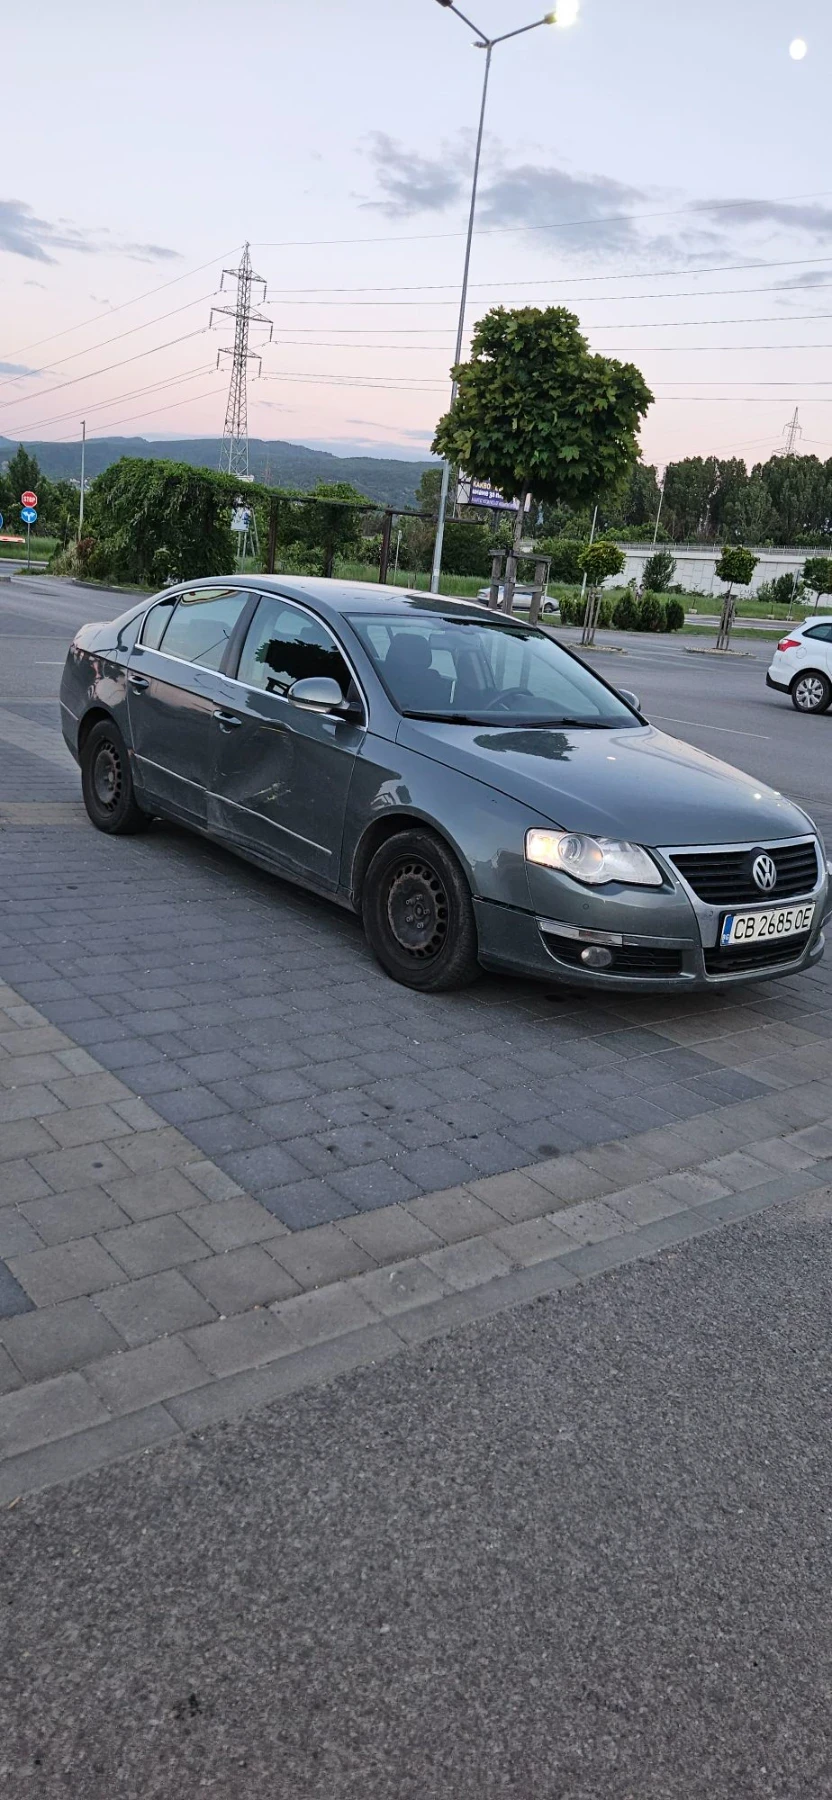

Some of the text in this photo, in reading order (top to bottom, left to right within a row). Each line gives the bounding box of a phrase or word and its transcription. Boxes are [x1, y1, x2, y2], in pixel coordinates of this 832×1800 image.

[734, 908, 812, 939] CB 2685 OE
